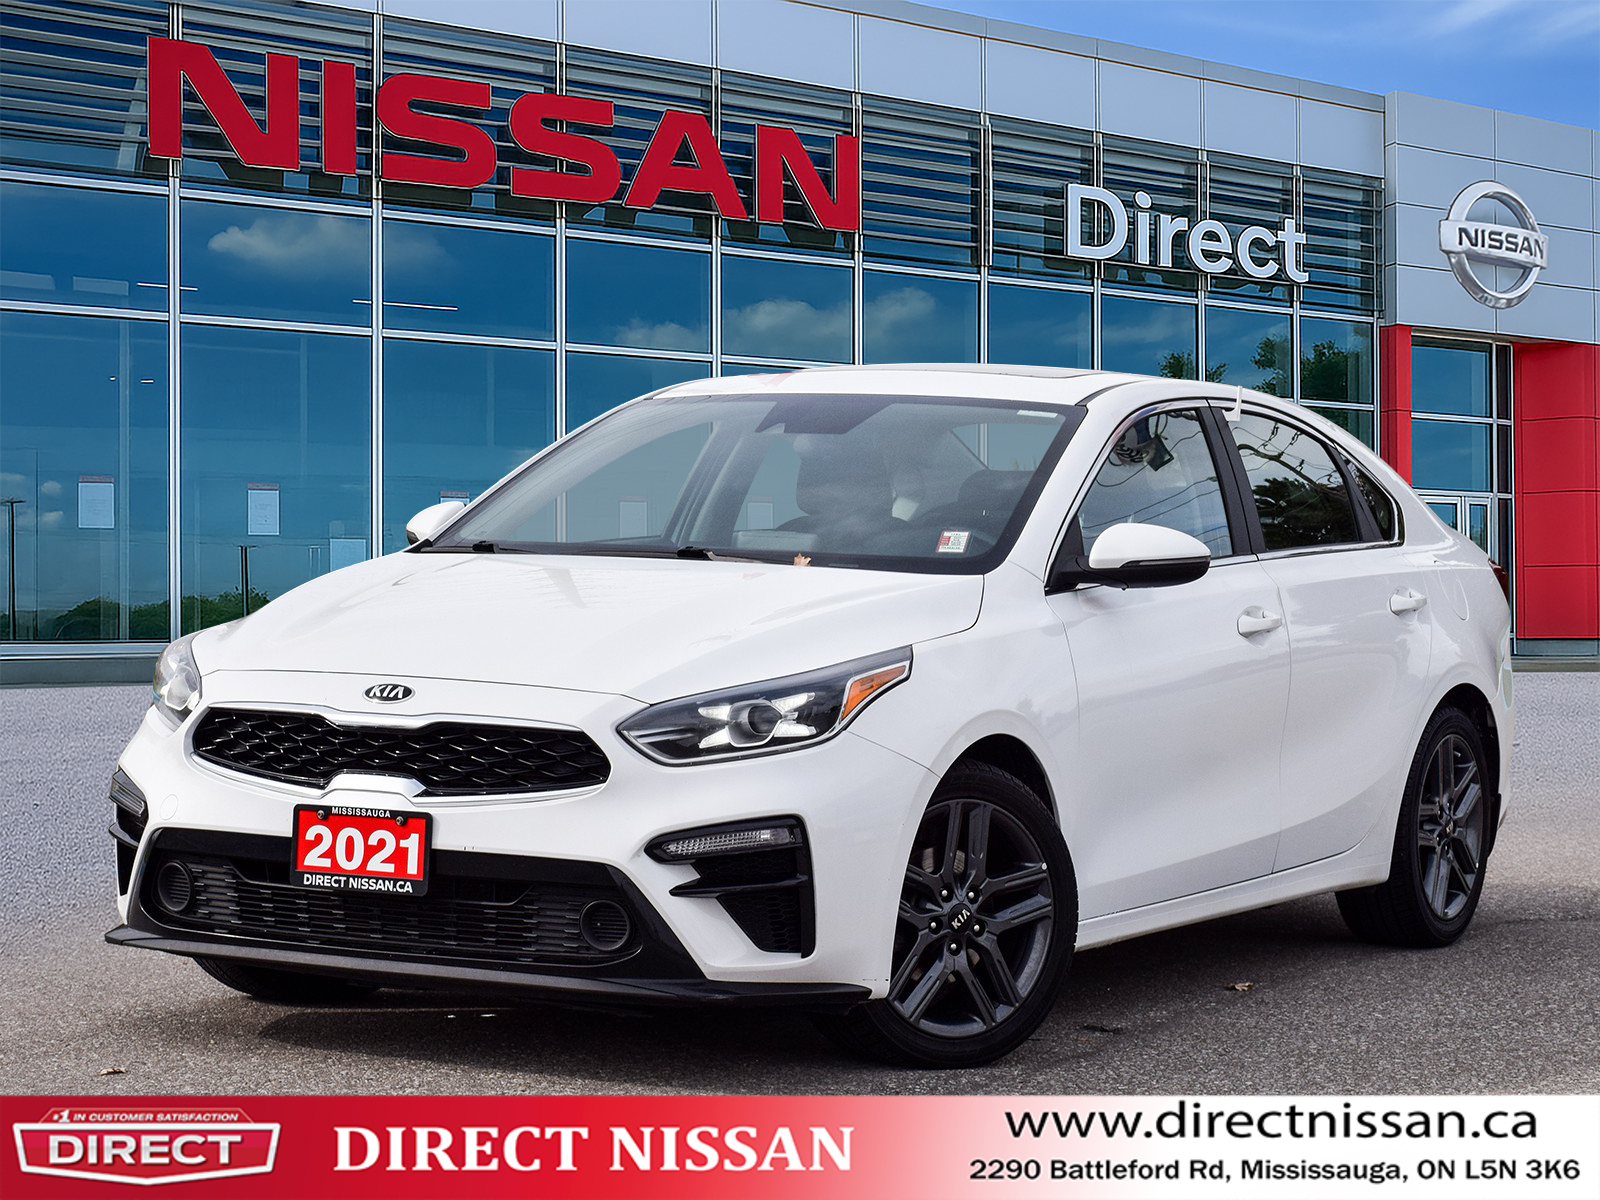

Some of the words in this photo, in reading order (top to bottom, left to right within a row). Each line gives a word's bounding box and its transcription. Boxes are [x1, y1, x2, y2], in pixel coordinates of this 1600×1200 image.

[148, 36, 862, 233] NISSAN
[1064, 183, 1310, 284] Direct
[1457, 226, 1546, 260] NISSAN
[368, 684, 405, 699] KIA
[331, 806, 391, 818] MISSISSAUGA
[303, 824, 420, 875] 2021
[303, 873, 347, 888] DIRECT
[348, 877, 413, 893] NISSAN.CA
[951, 908, 971, 930] KIA
